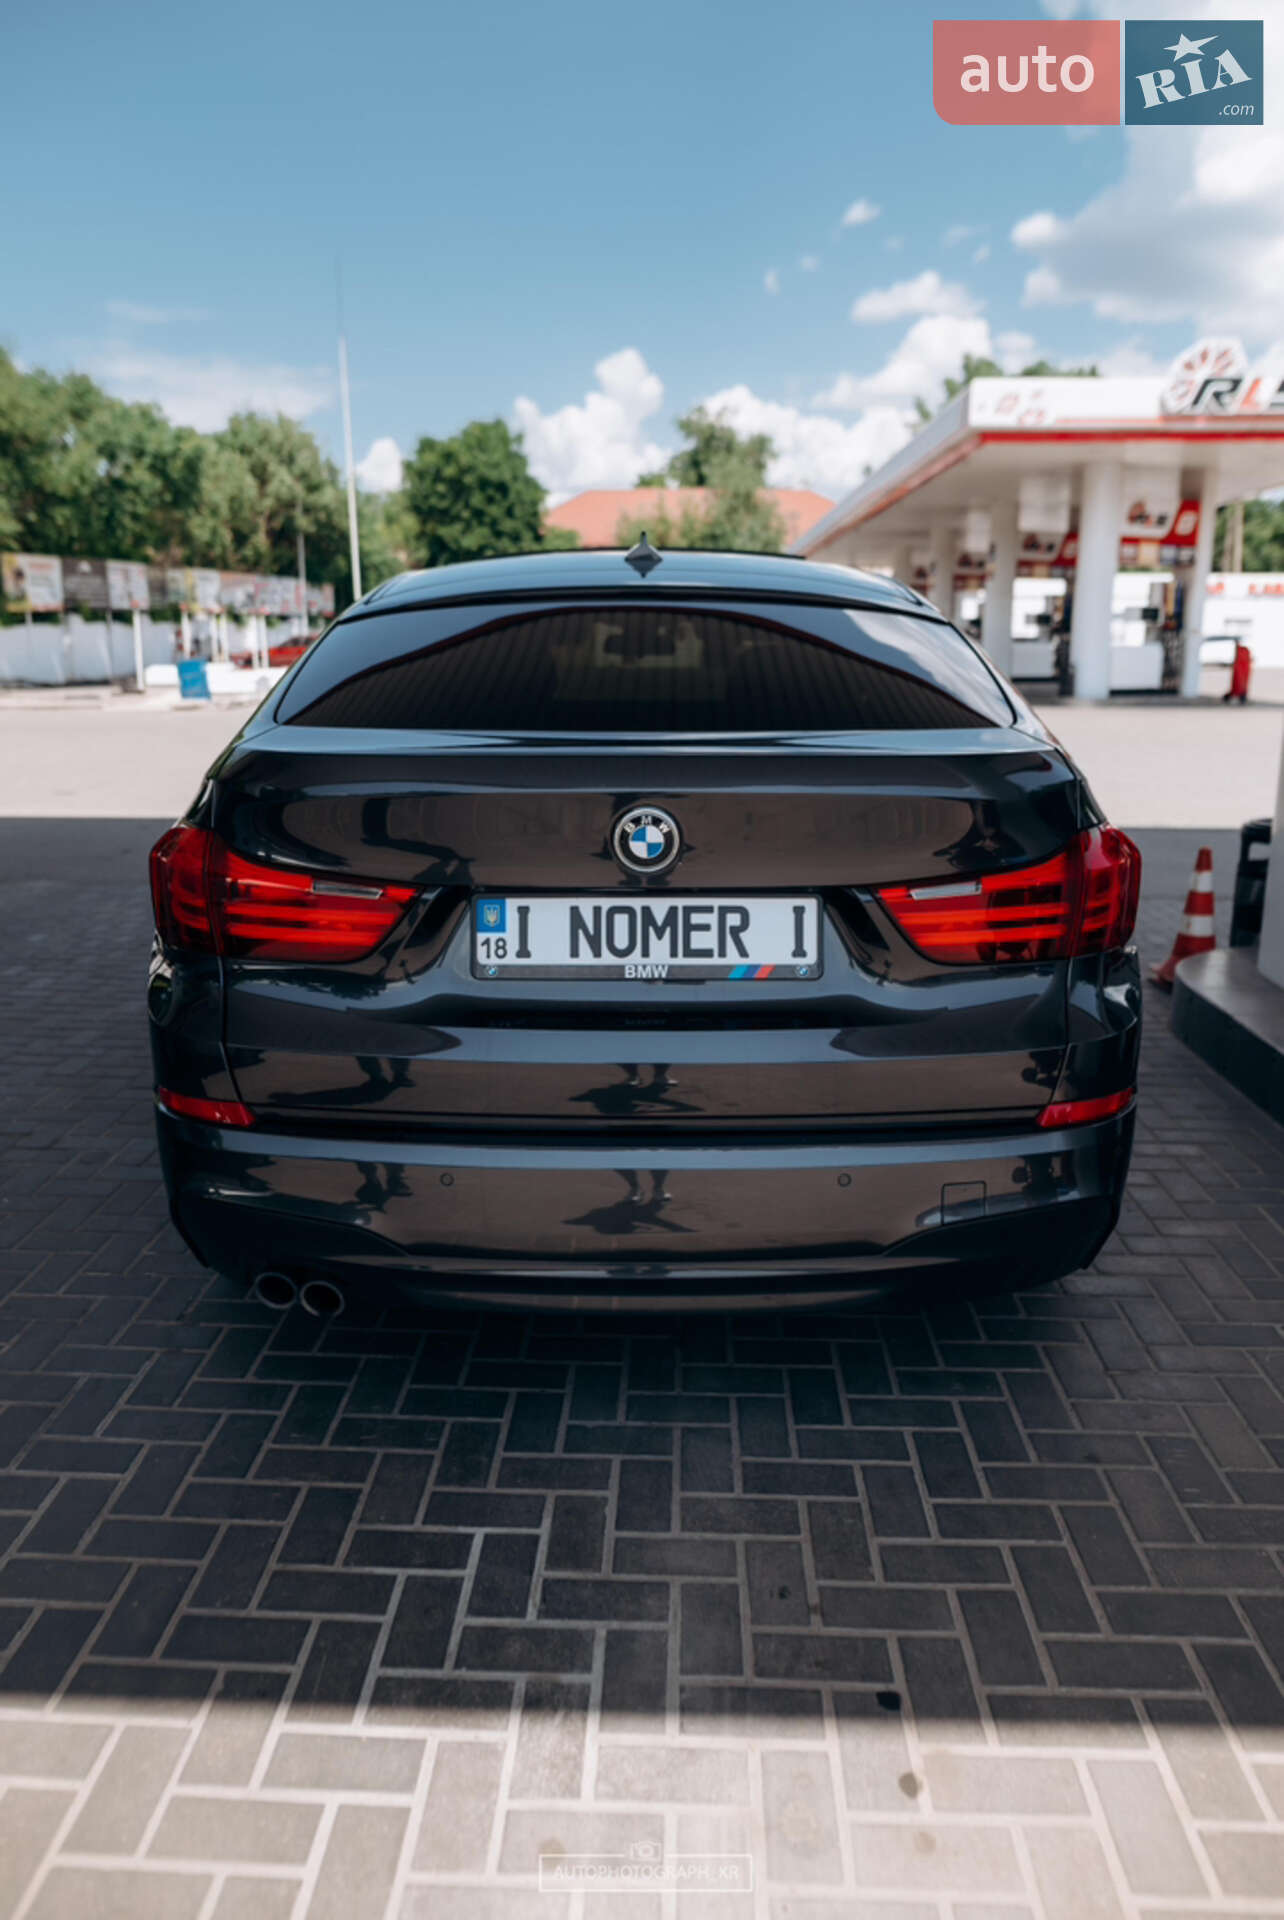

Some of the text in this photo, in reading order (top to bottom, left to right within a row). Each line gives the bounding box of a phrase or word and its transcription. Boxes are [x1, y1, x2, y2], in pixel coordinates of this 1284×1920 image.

[569, 905, 751, 959] NOMER
[480, 937, 508, 960] 18
[624, 965, 670, 979] BMW
